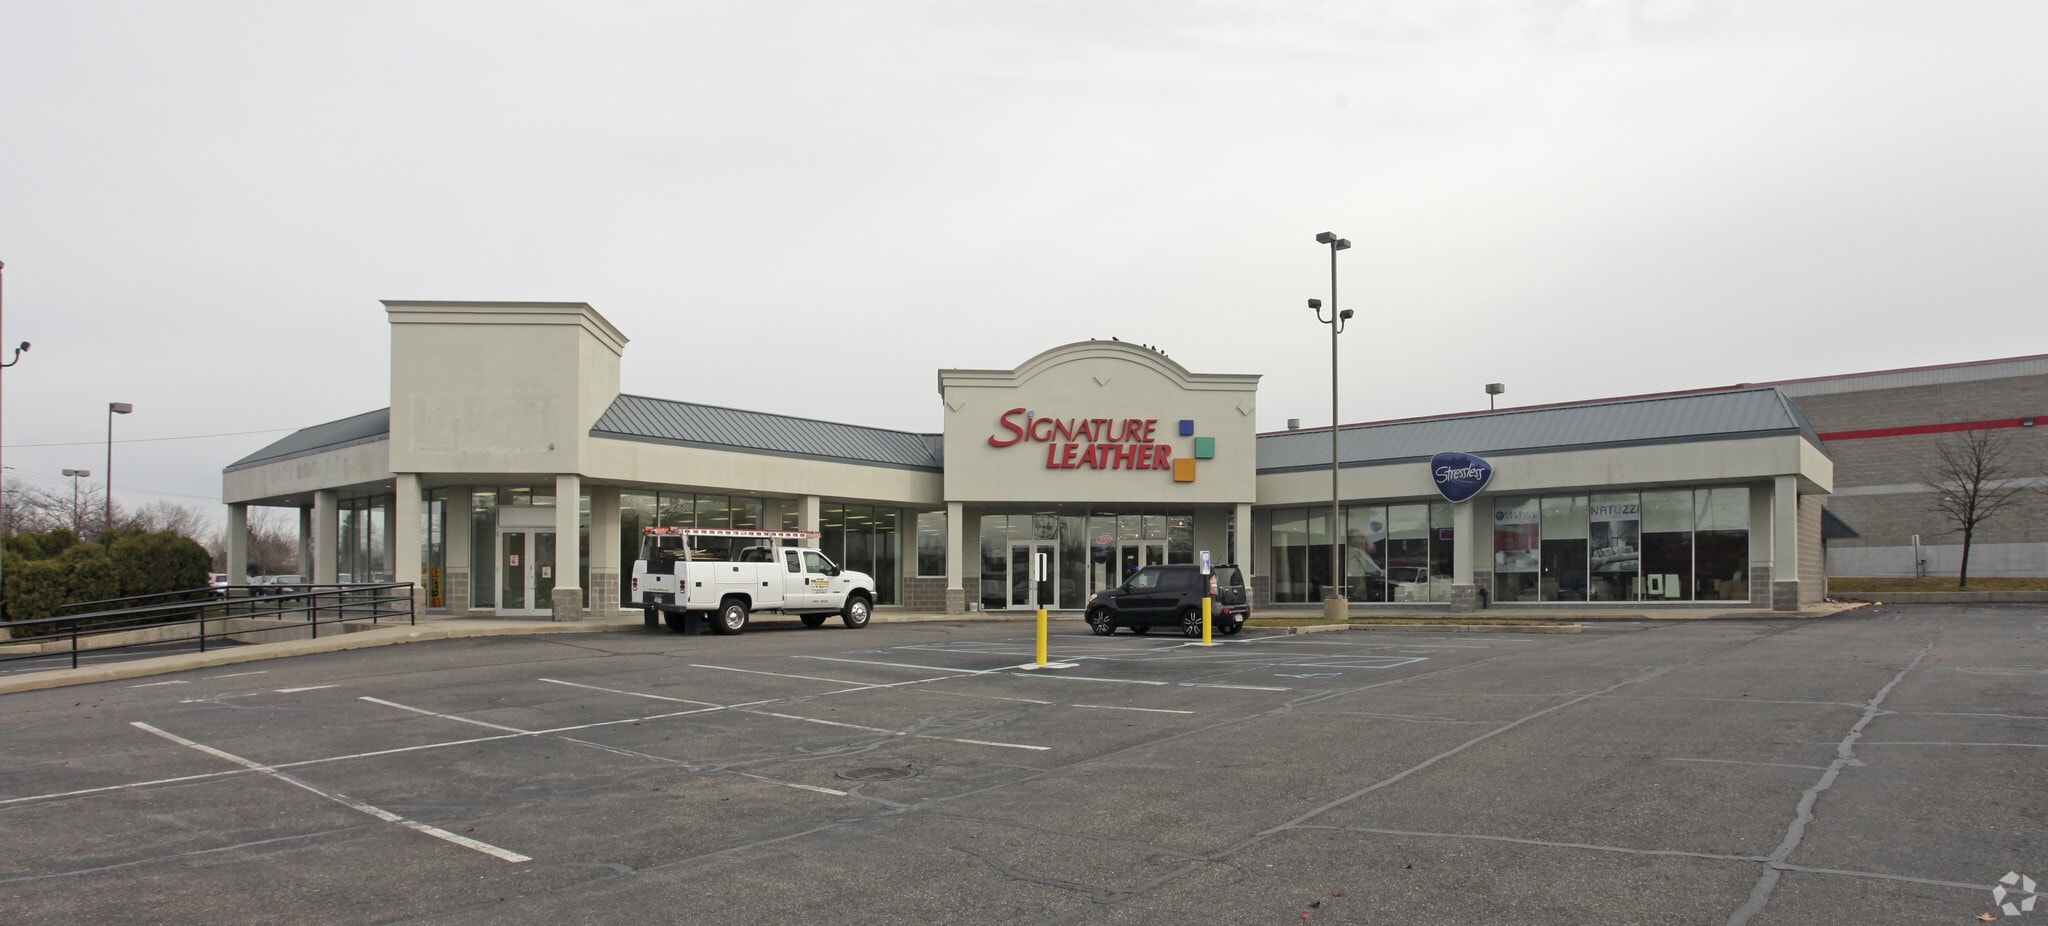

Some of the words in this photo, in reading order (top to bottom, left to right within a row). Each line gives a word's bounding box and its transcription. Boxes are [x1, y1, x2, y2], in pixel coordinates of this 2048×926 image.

[988, 408, 1158, 447] SIGNATURE
[1046, 443, 1172, 469] LEATHER
[1435, 462, 1486, 483] Stressless
